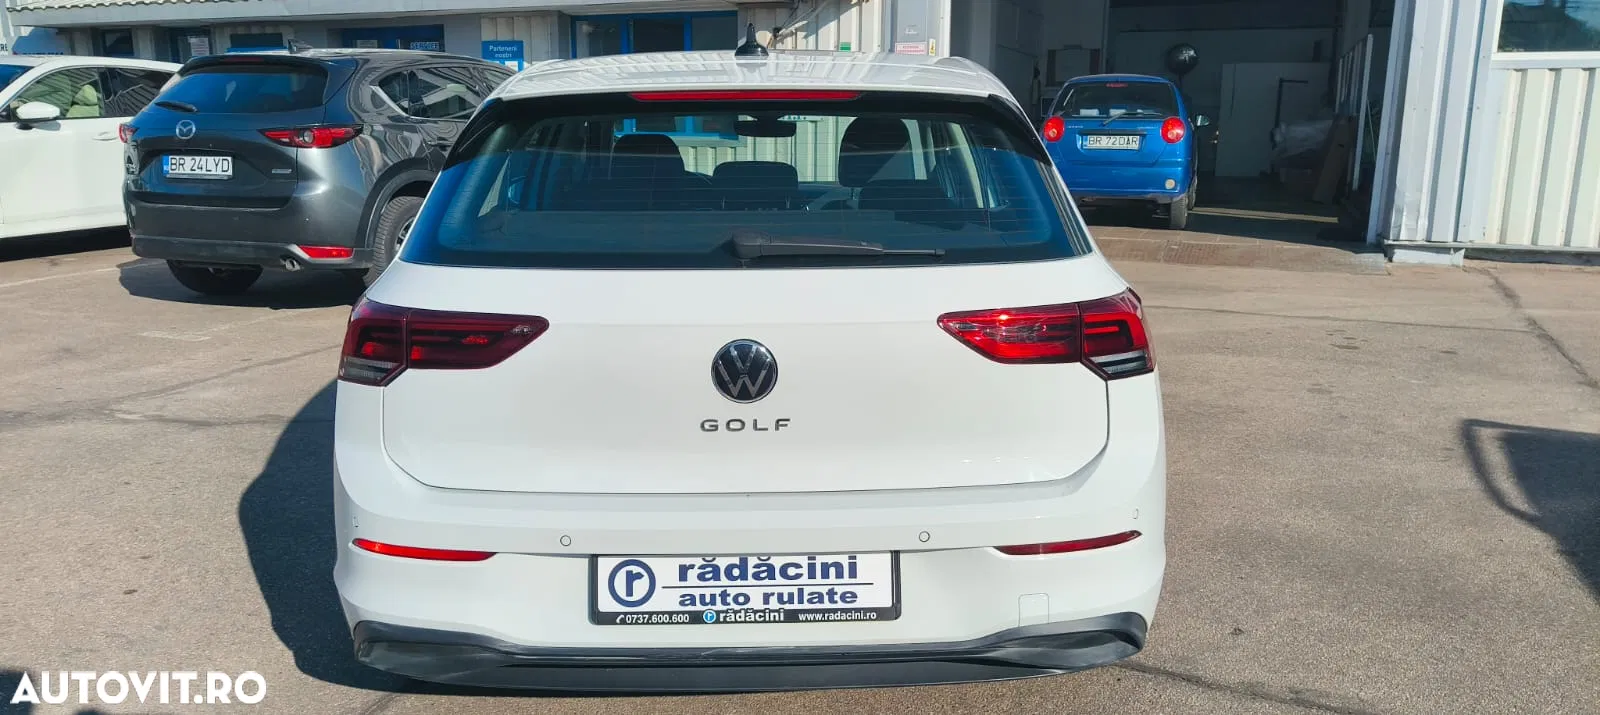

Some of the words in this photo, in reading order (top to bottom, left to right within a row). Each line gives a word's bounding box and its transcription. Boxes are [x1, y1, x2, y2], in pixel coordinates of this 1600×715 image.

[170, 157, 186, 171] BR
[700, 418, 791, 432] GOLF
[678, 555, 858, 583] rădăcini
[678, 589, 751, 607] auto
[762, 587, 858, 605] rulate
[625, 613, 690, 624] 0737.600.600
[719, 609, 785, 622] rădăcini
[798, 610, 877, 622] www.radacini.ro
